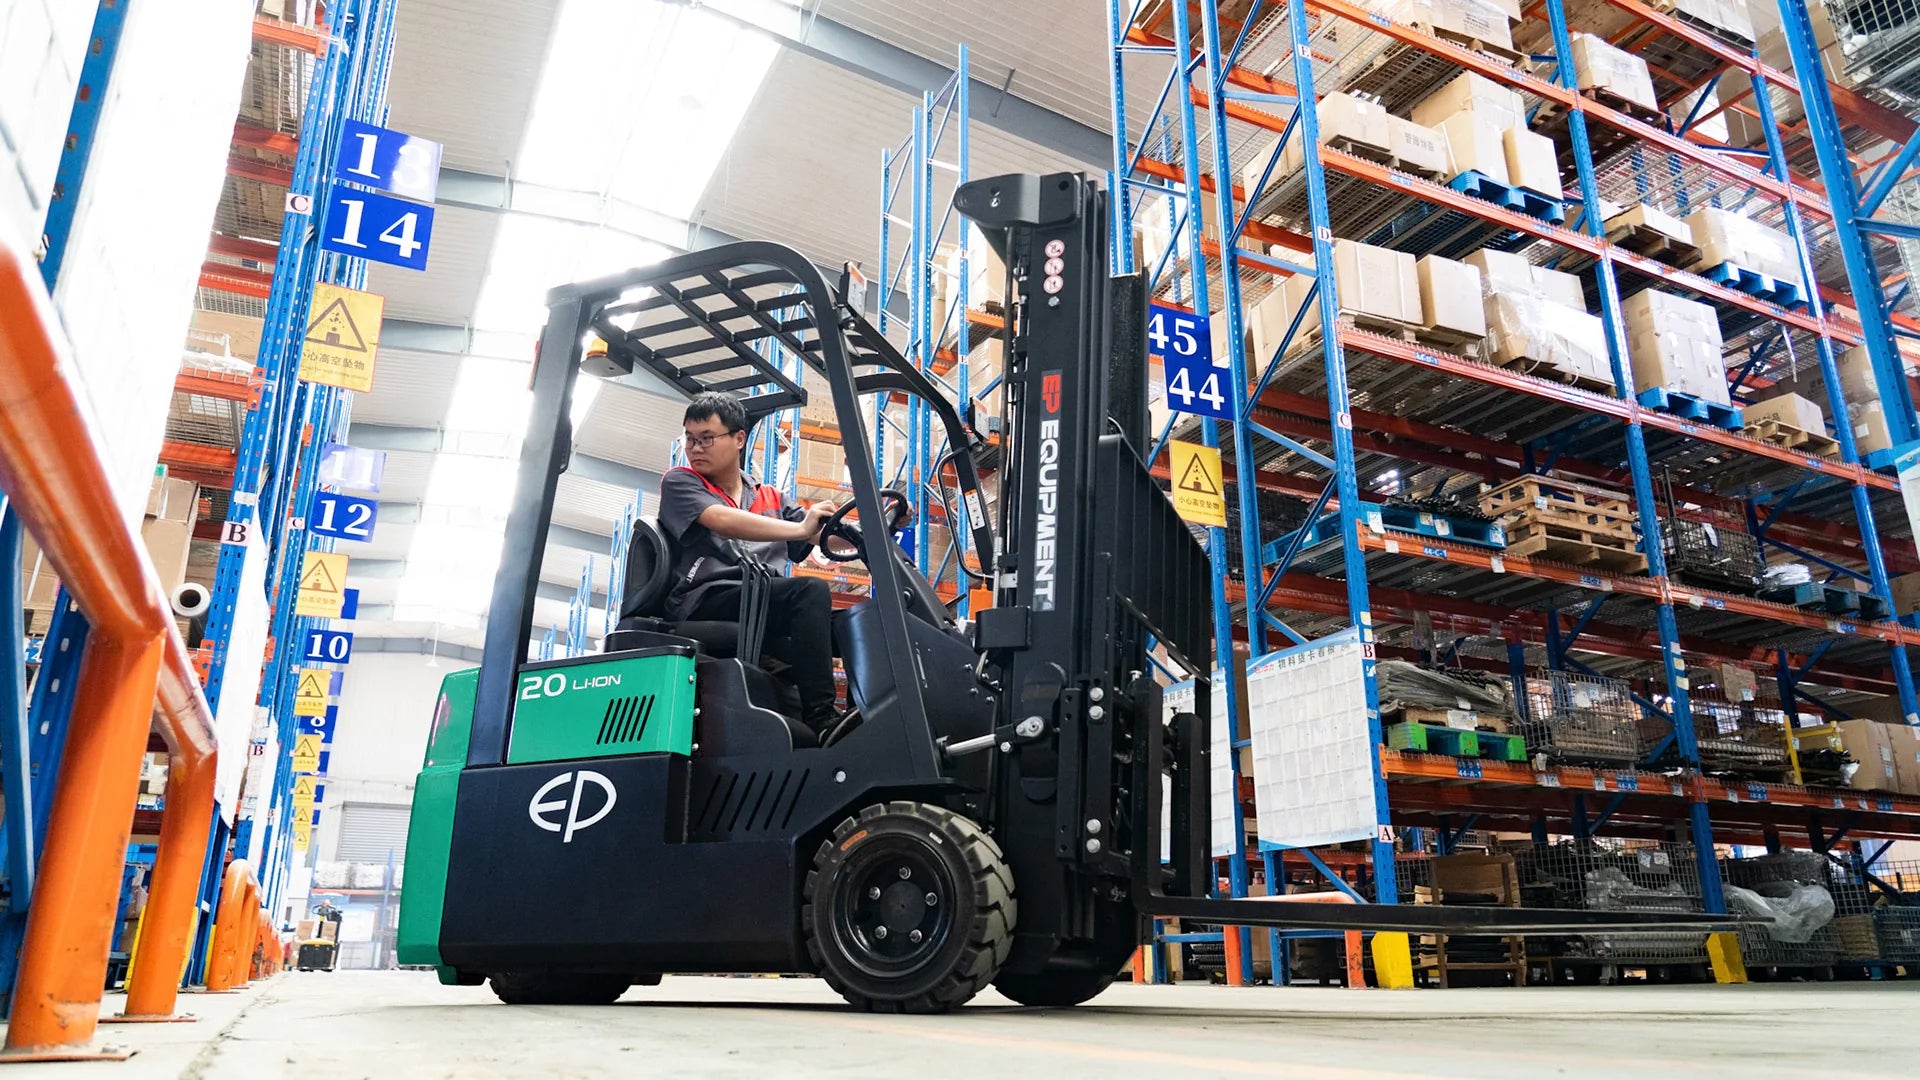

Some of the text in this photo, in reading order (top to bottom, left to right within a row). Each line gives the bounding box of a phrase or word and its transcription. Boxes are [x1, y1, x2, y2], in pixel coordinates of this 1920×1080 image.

[347, 132, 432, 189] 13
[290, 196, 309, 212] C
[332, 199, 422, 258] 14
[1319, 228, 1330, 239] D
[1148, 313, 1198, 356] 45
[303, 351, 365, 370] 心高空坠物
[1168, 367, 1225, 411] 44
[1339, 414, 1350, 426] C
[324, 450, 376, 486] 11
[1035, 374, 1062, 603] EP EQUIPMENT
[315, 500, 371, 536] 12
[227, 523, 247, 543] B
[307, 634, 349, 660] 10
[1363, 644, 1373, 658] B
[521, 673, 567, 700] 20
[253, 745, 264, 756] B
[1458, 769, 1482, 778] 44-A-1
[529, 770, 617, 843] EP
[1381, 827, 1393, 841] A
